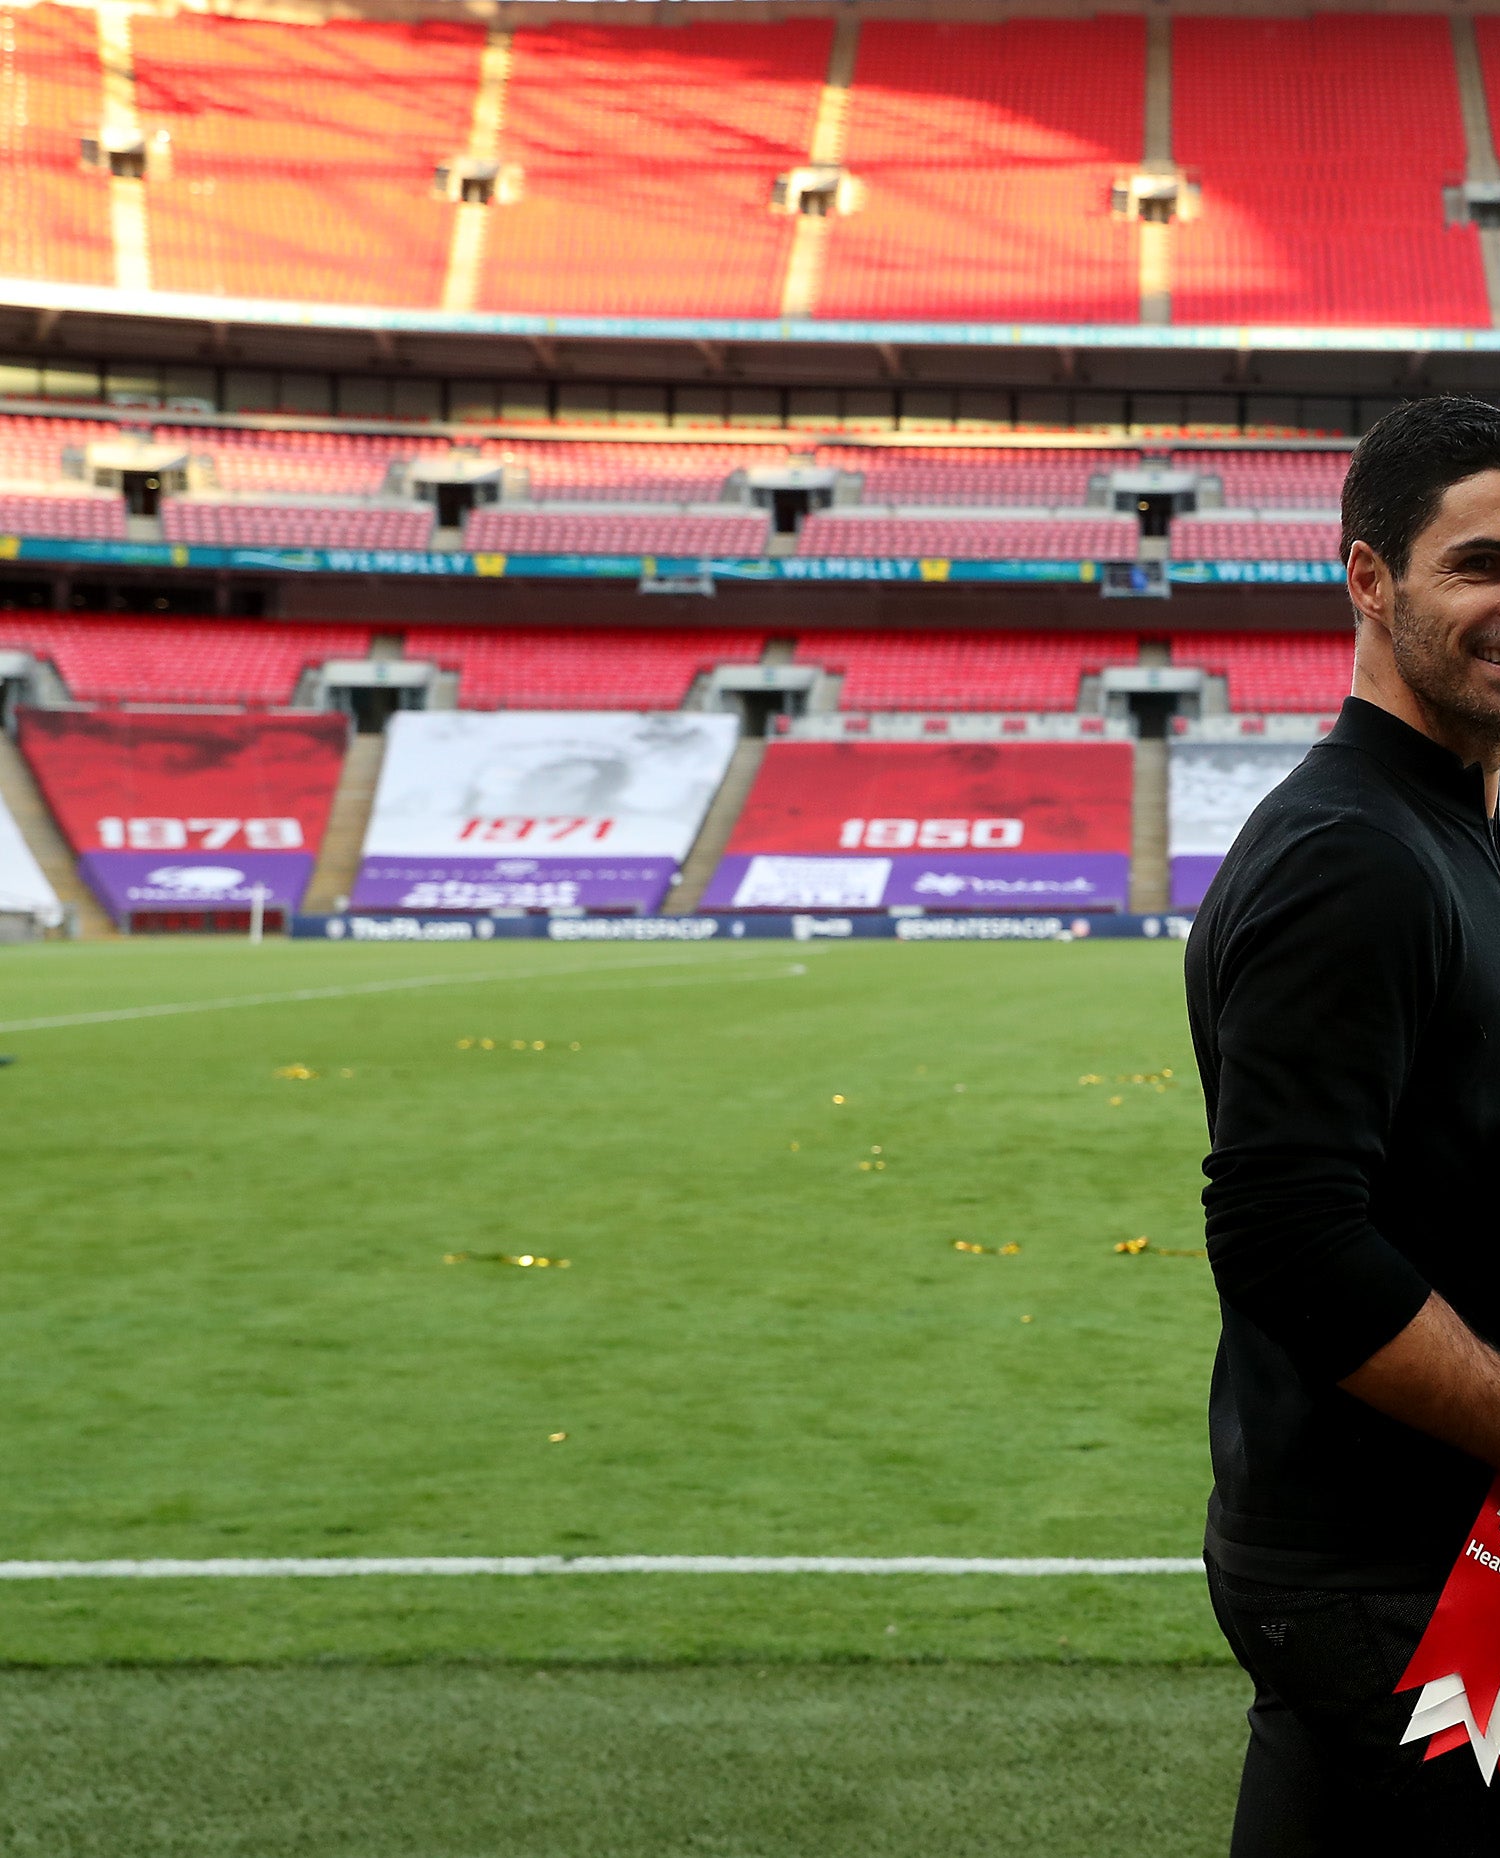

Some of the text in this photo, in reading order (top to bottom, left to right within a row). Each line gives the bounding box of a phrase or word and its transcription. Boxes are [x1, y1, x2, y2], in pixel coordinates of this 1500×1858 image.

[327, 551, 467, 574] WEMBLEY
[781, 557, 913, 579] WEMBLEY
[1216, 560, 1345, 582] WEMBLEY
[97, 816, 304, 849] 1979
[457, 817, 615, 841] 1971
[838, 818, 1024, 848] 1950
[351, 917, 473, 940] TheFA.com
